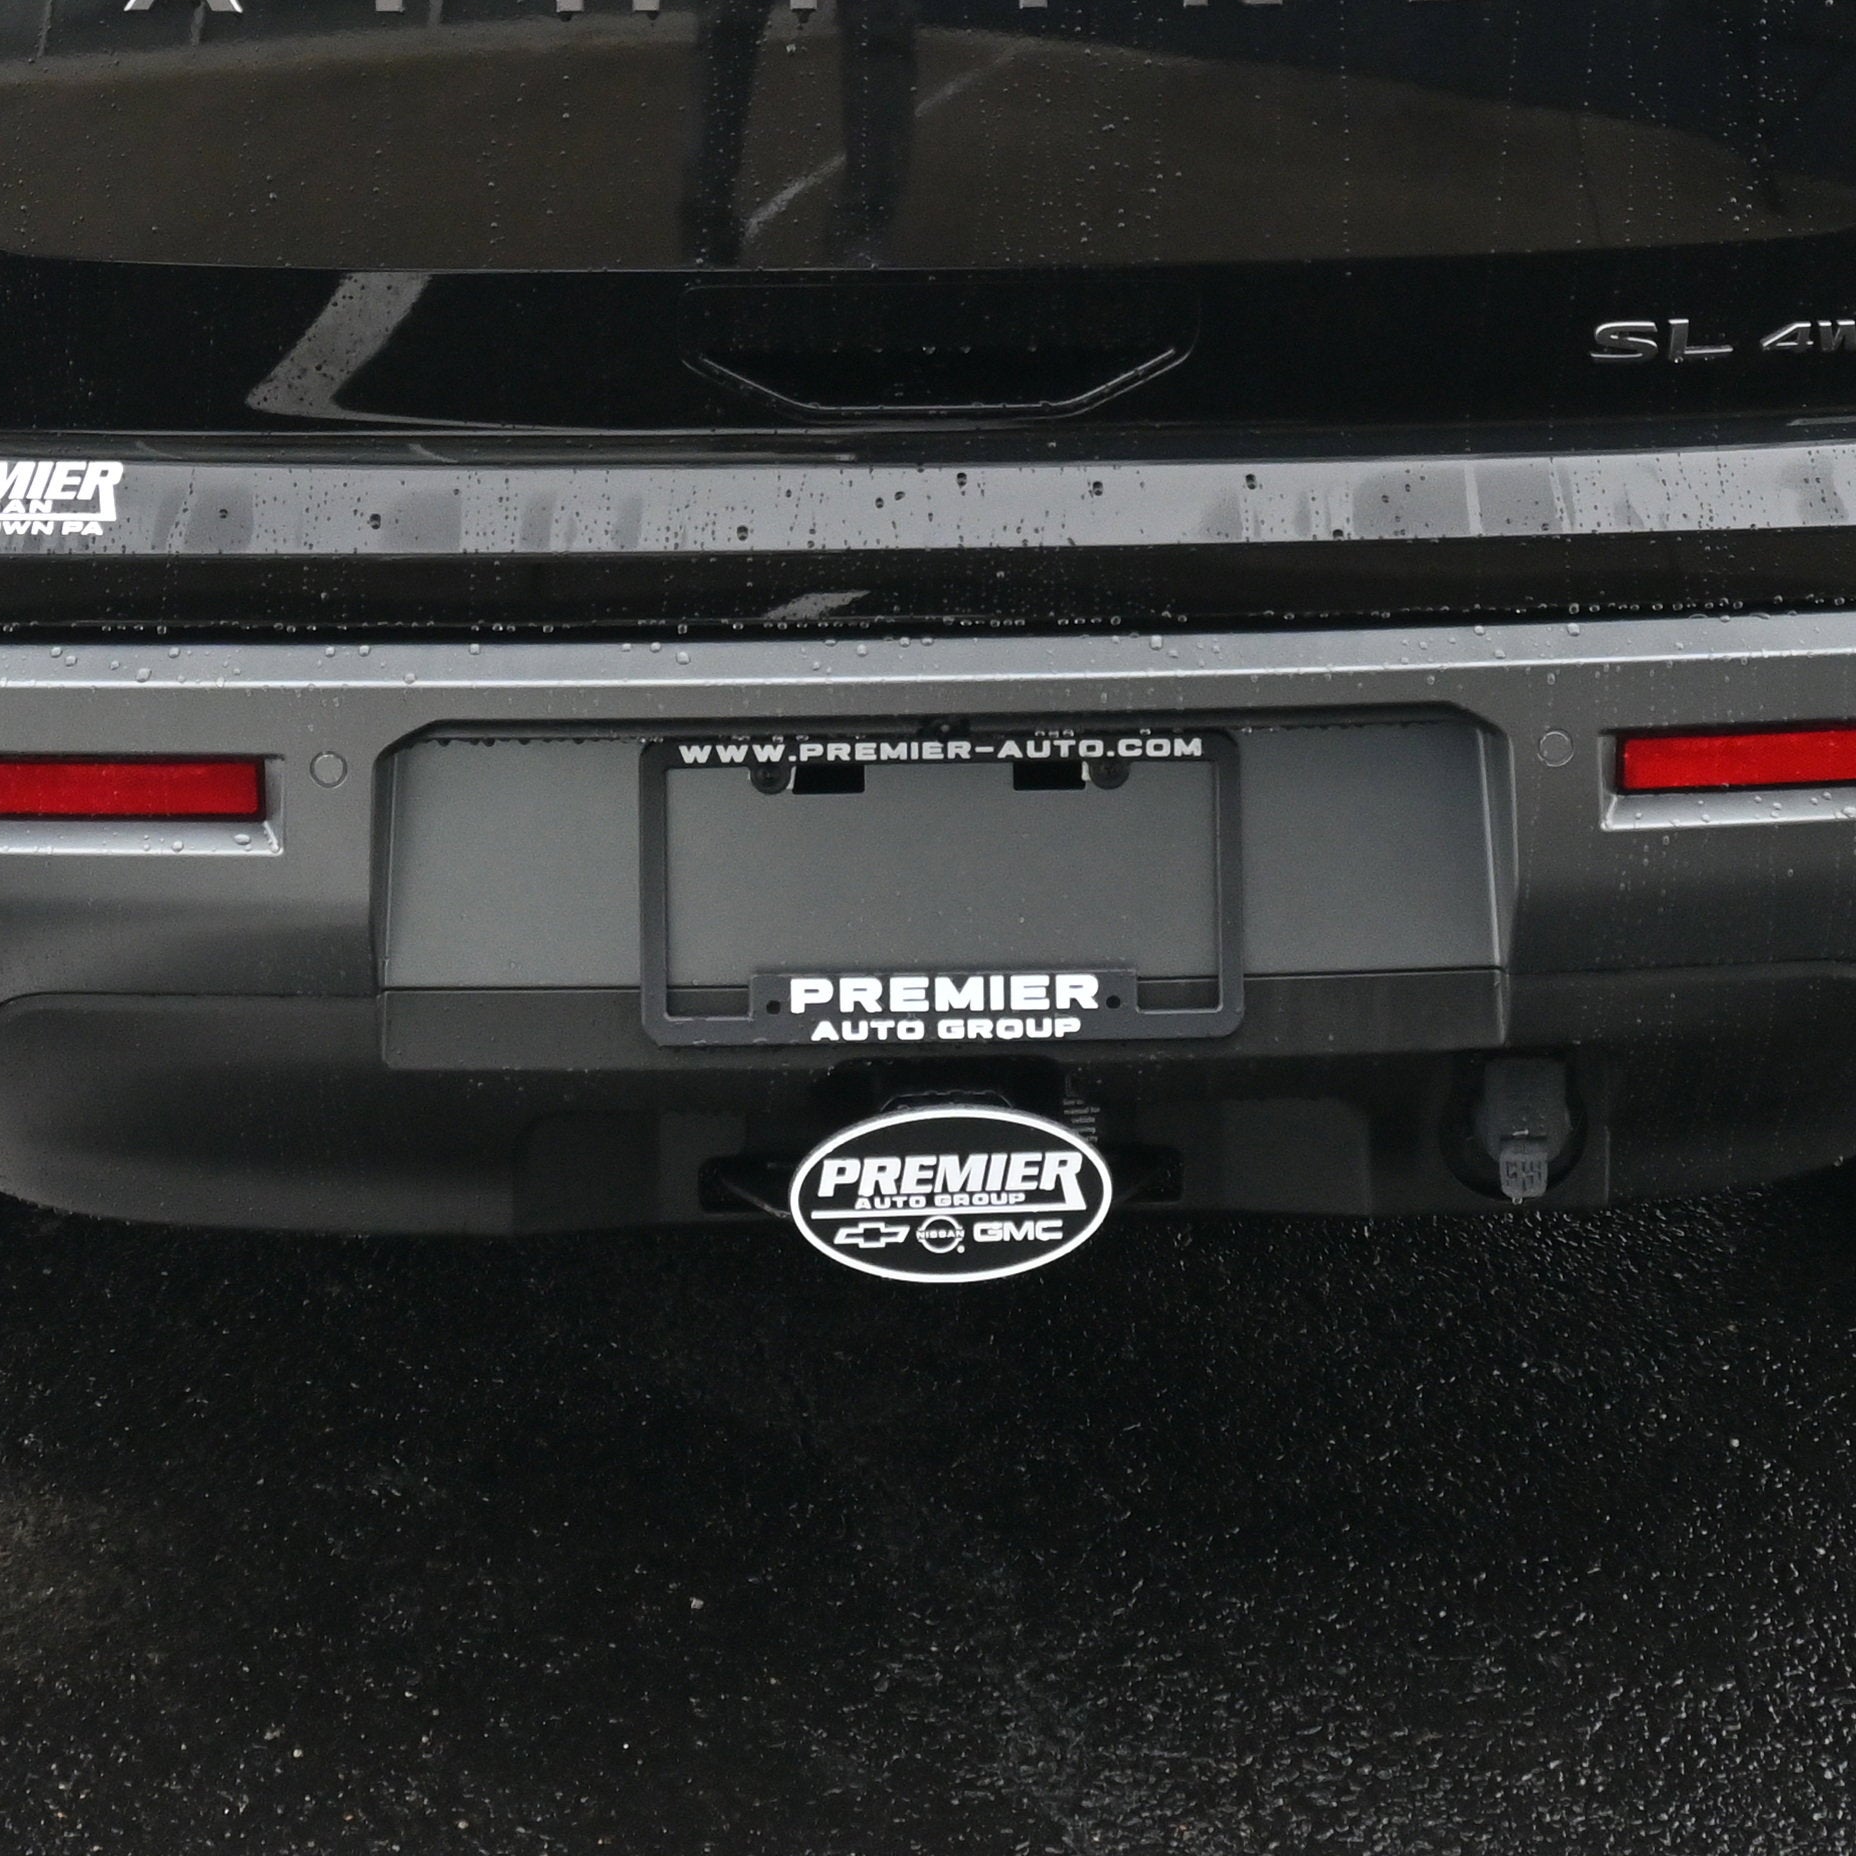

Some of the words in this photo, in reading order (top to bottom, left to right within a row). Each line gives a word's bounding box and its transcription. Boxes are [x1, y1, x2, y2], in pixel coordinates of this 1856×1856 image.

[1590, 318, 1733, 362] SL
[61, 520, 104, 536] PA
[680, 738, 1203, 764] WWW.PREMIER-AUTO.COM
[790, 974, 1099, 1014] PREMIER
[811, 1020, 925, 1041] AUTO
[937, 1017, 1082, 1040] GROUP
[817, 1151, 1087, 1209] PREMIER
[854, 1195, 926, 1210] AUTO
[934, 1192, 1026, 1208] GROUP
[973, 1219, 1063, 1243] GMC
